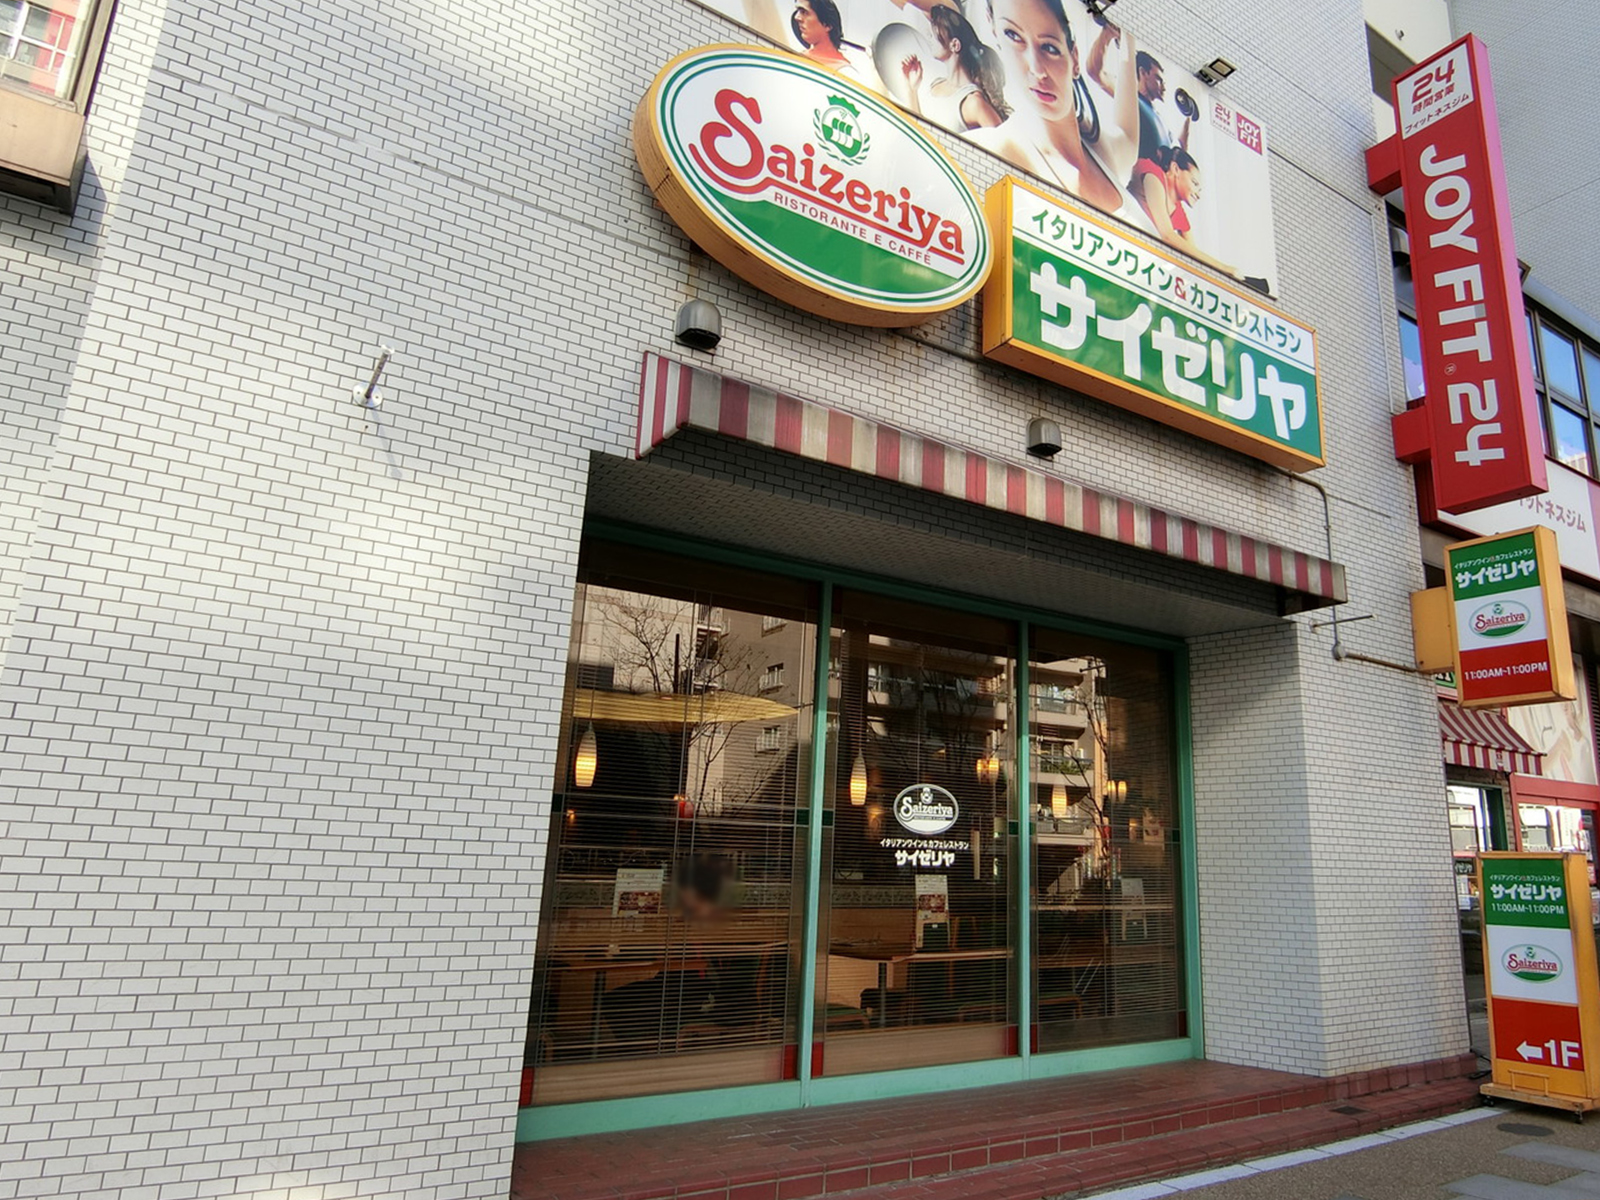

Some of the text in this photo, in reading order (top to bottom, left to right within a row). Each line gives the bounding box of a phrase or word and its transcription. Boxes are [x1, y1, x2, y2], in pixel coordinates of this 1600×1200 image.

[1412, 58, 1455, 104] 24
[1215, 102, 1231, 120] 24
[1405, 93, 1469, 134] フィットネスジム
[1237, 119, 1260, 137] JOY
[1240, 130, 1259, 148] FIT
[698, 88, 965, 256] Saizeriya
[774, 191, 867, 239] RISTORANTE
[874, 233, 883, 246] E
[1032, 209, 1302, 354] イタリアンワイン&カフェレストラン
[1030, 261, 1307, 441] サイゼリヤ
[1447, 379, 1505, 467] 24
[1455, 559, 1536, 589] サイゼリヤ
[1474, 612, 1526, 631] Saizeriya
[900, 796, 954, 817] Saizeriya
[895, 849, 956, 867] サイゼリヤ
[1490, 883, 1562, 901] サイゼリヤ
[1507, 953, 1558, 972] Saizeriya
[1544, 1039, 1580, 1068] 1F
